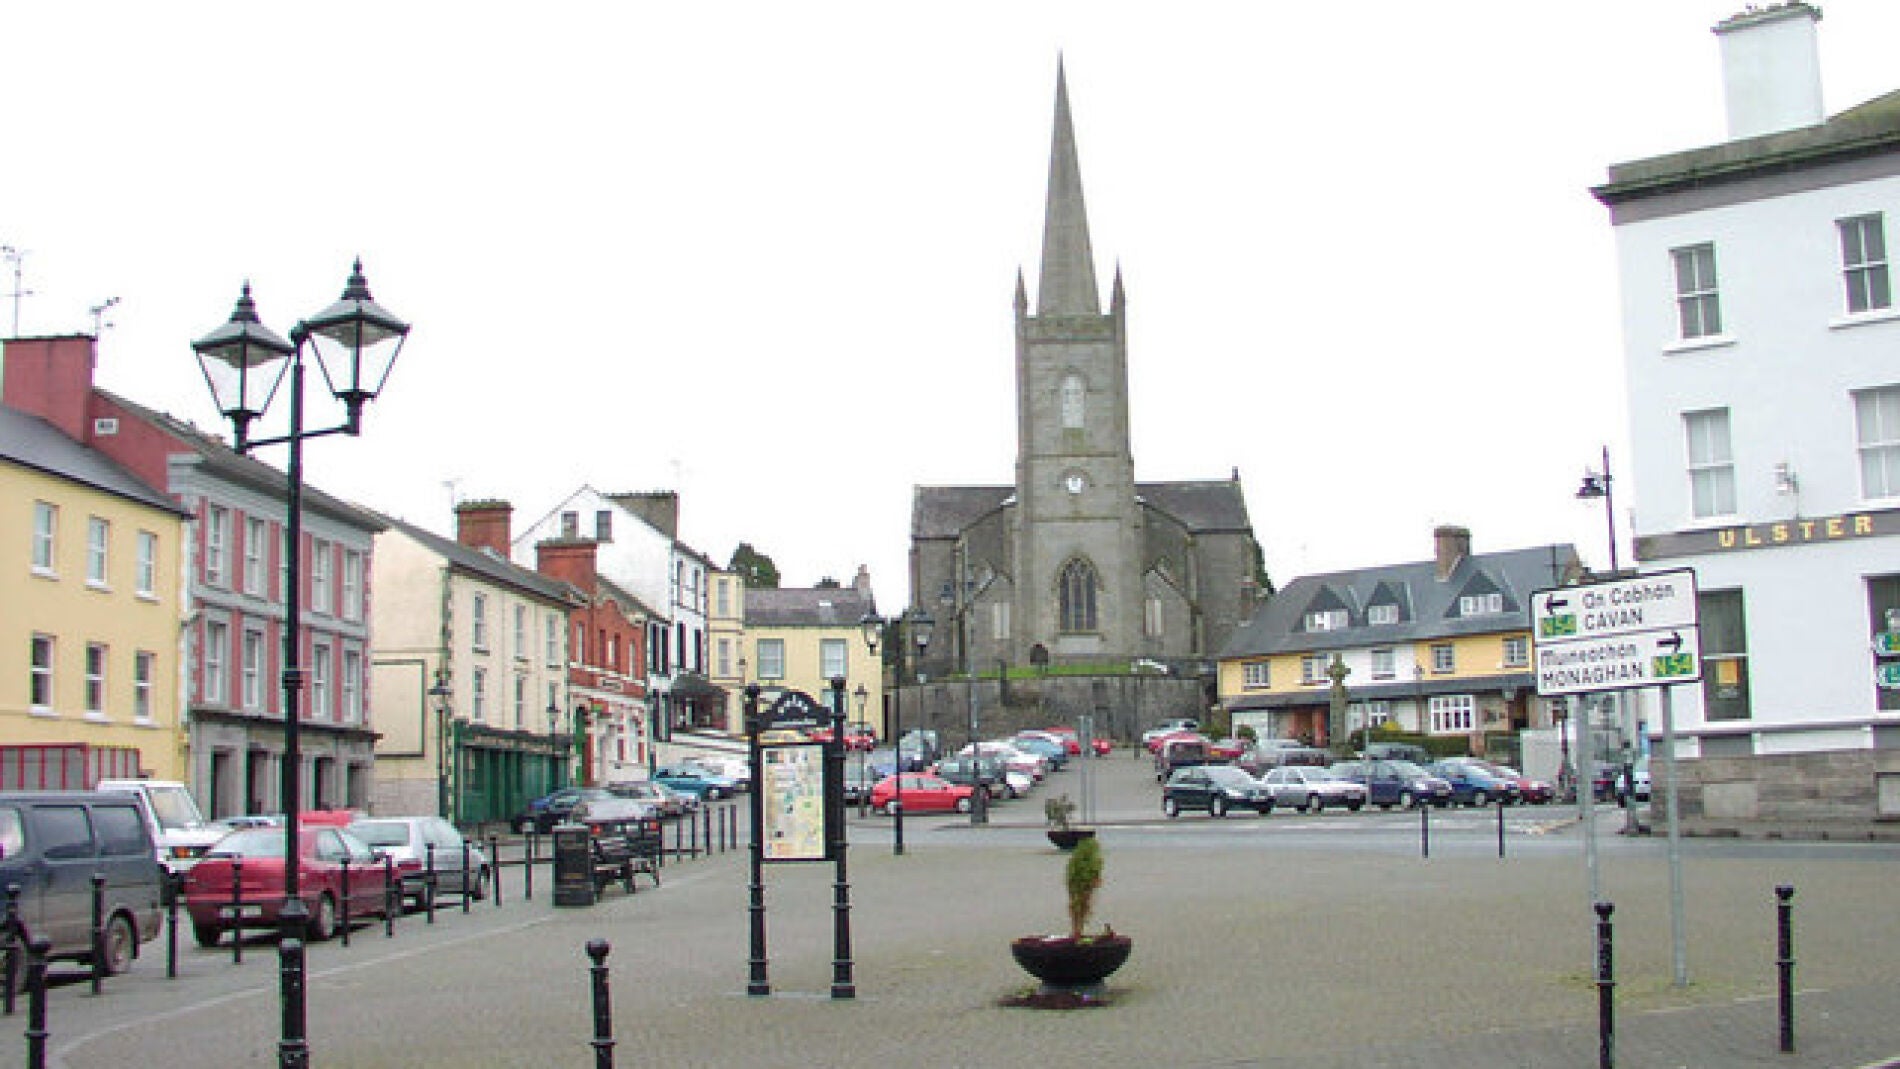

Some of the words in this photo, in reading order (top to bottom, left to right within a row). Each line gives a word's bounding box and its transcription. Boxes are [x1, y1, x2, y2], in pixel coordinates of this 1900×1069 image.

[1718, 515, 1873, 548] ULSTER
[1584, 608, 1643, 630] CAVAN
[1543, 661, 1643, 689] MONAGHAN
